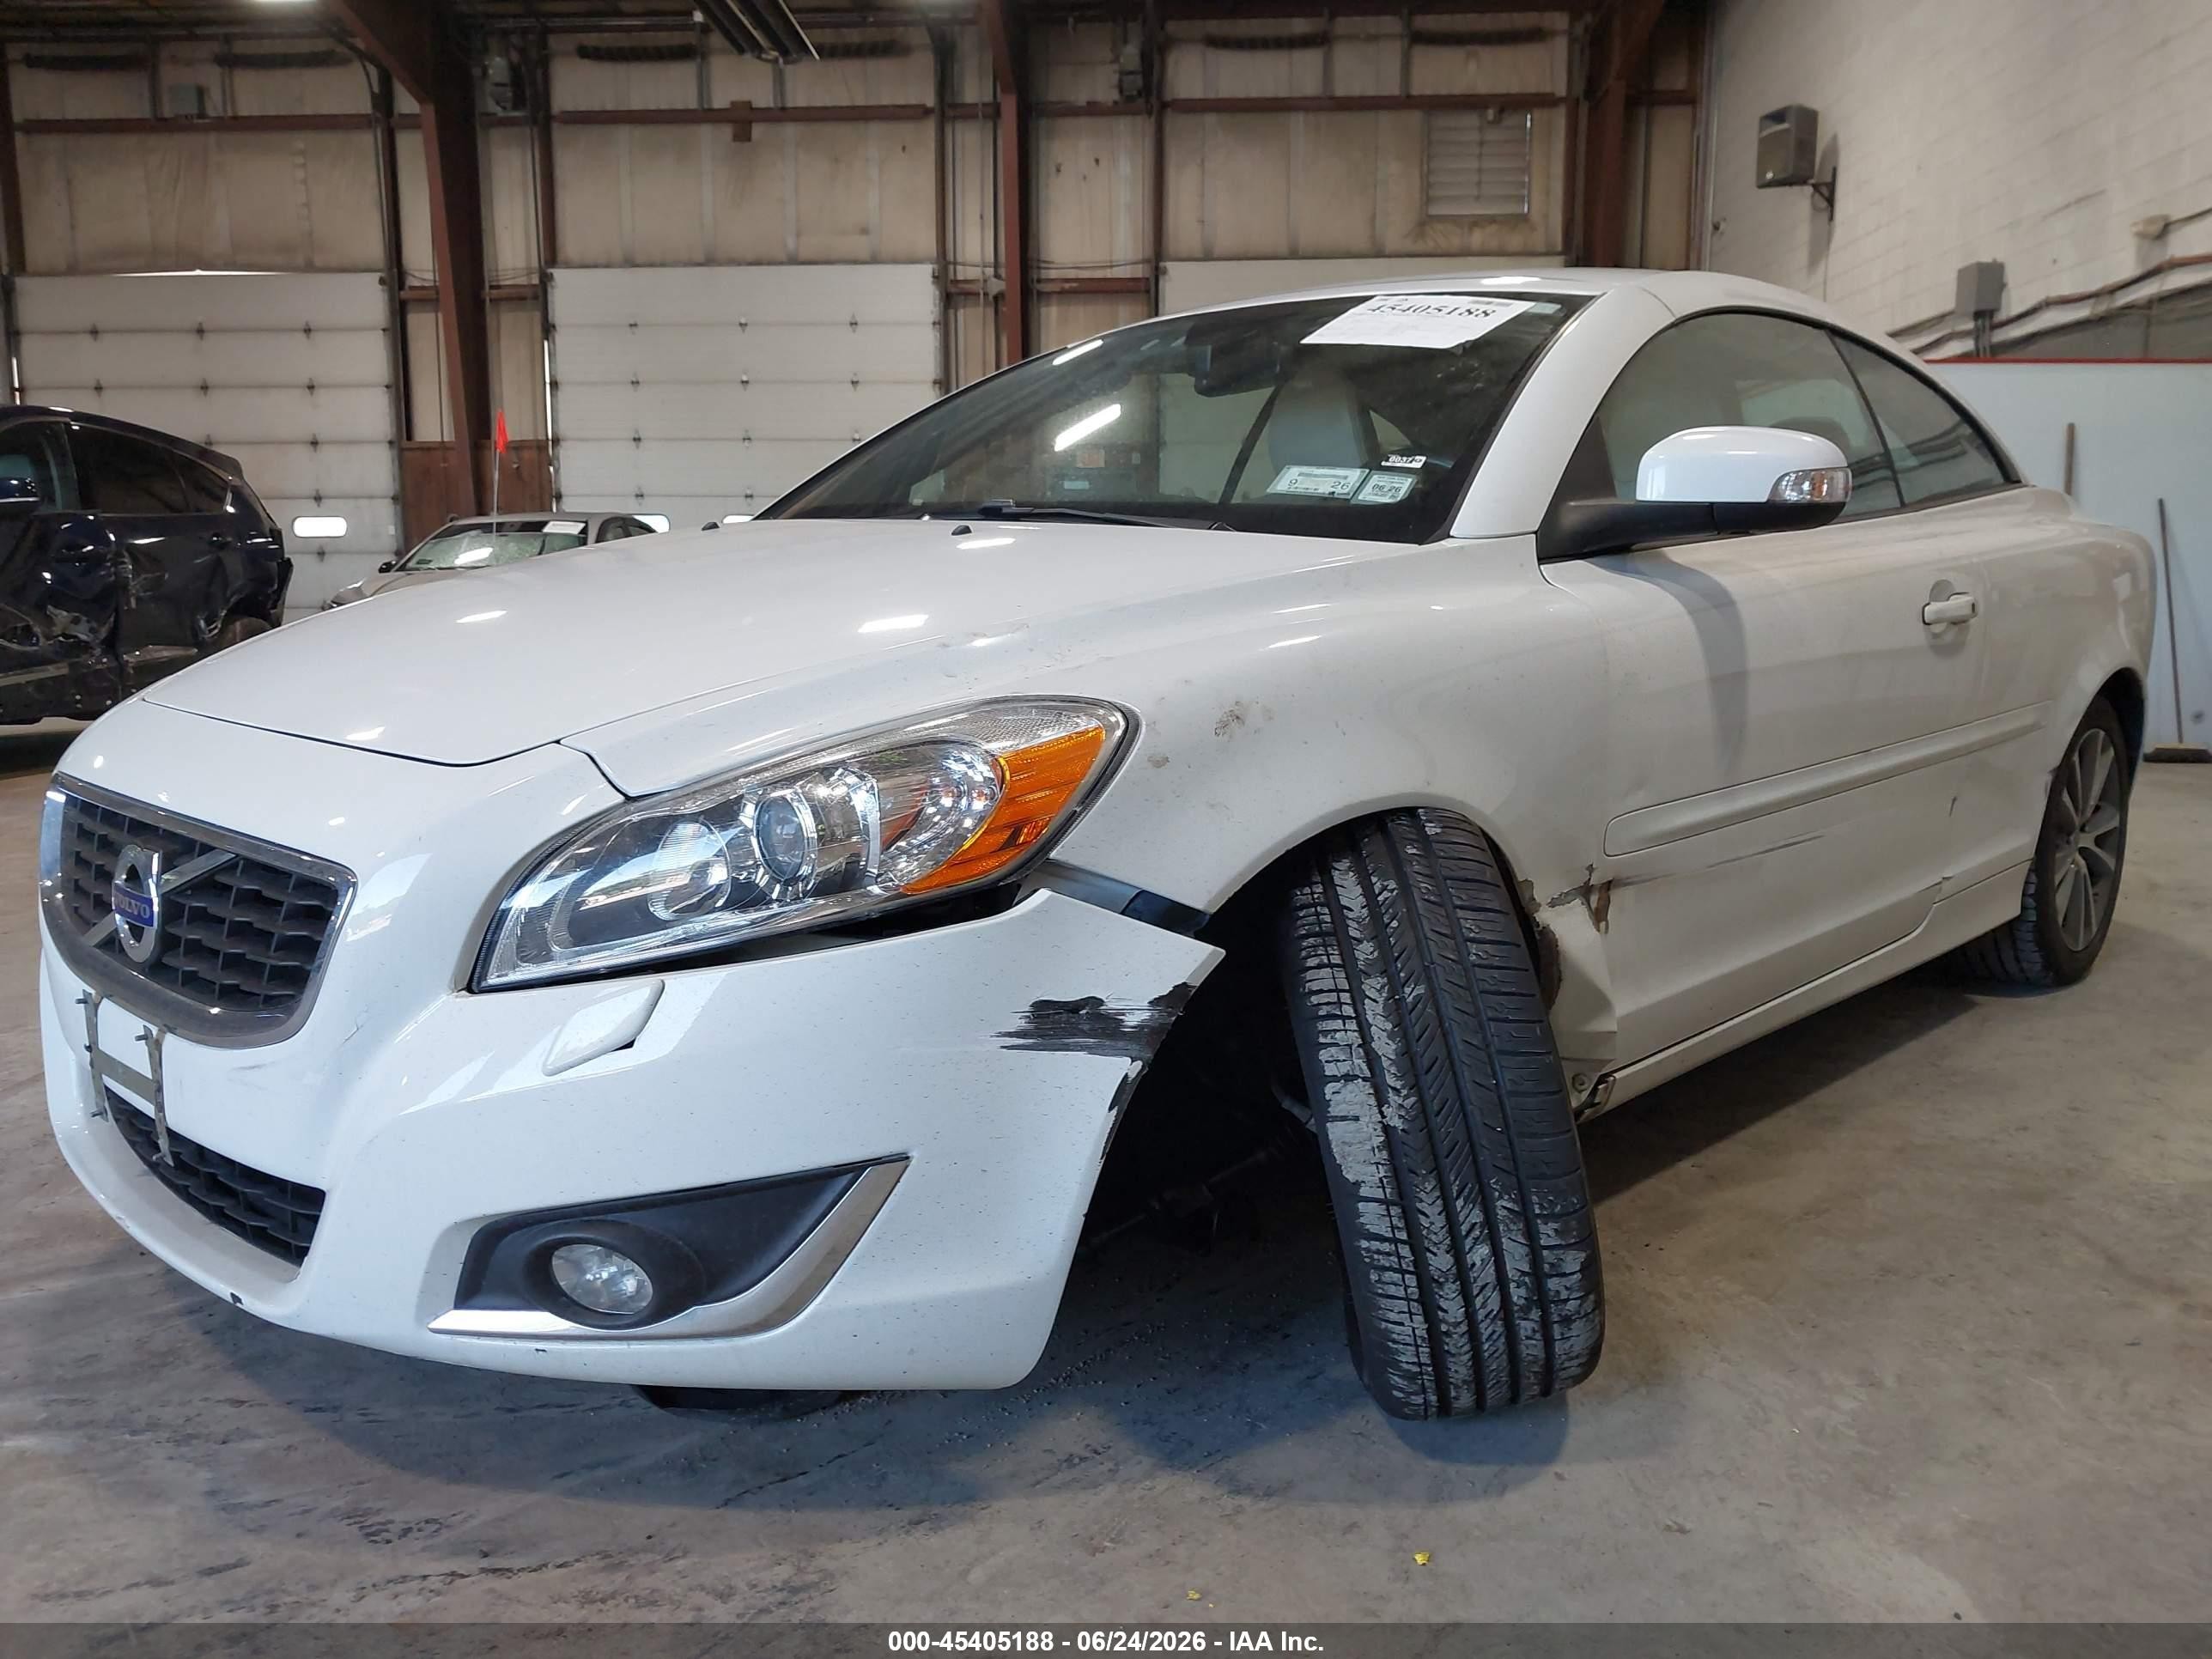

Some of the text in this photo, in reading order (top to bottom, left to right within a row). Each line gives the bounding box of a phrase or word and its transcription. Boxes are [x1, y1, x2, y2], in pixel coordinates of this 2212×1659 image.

[1367, 303, 1497, 319] 45405188
[1287, 478, 1297, 487] 9
[1331, 481, 1351, 490] 26
[1372, 483, 1387, 492] 06
[114, 892, 150, 919] VOLVO
